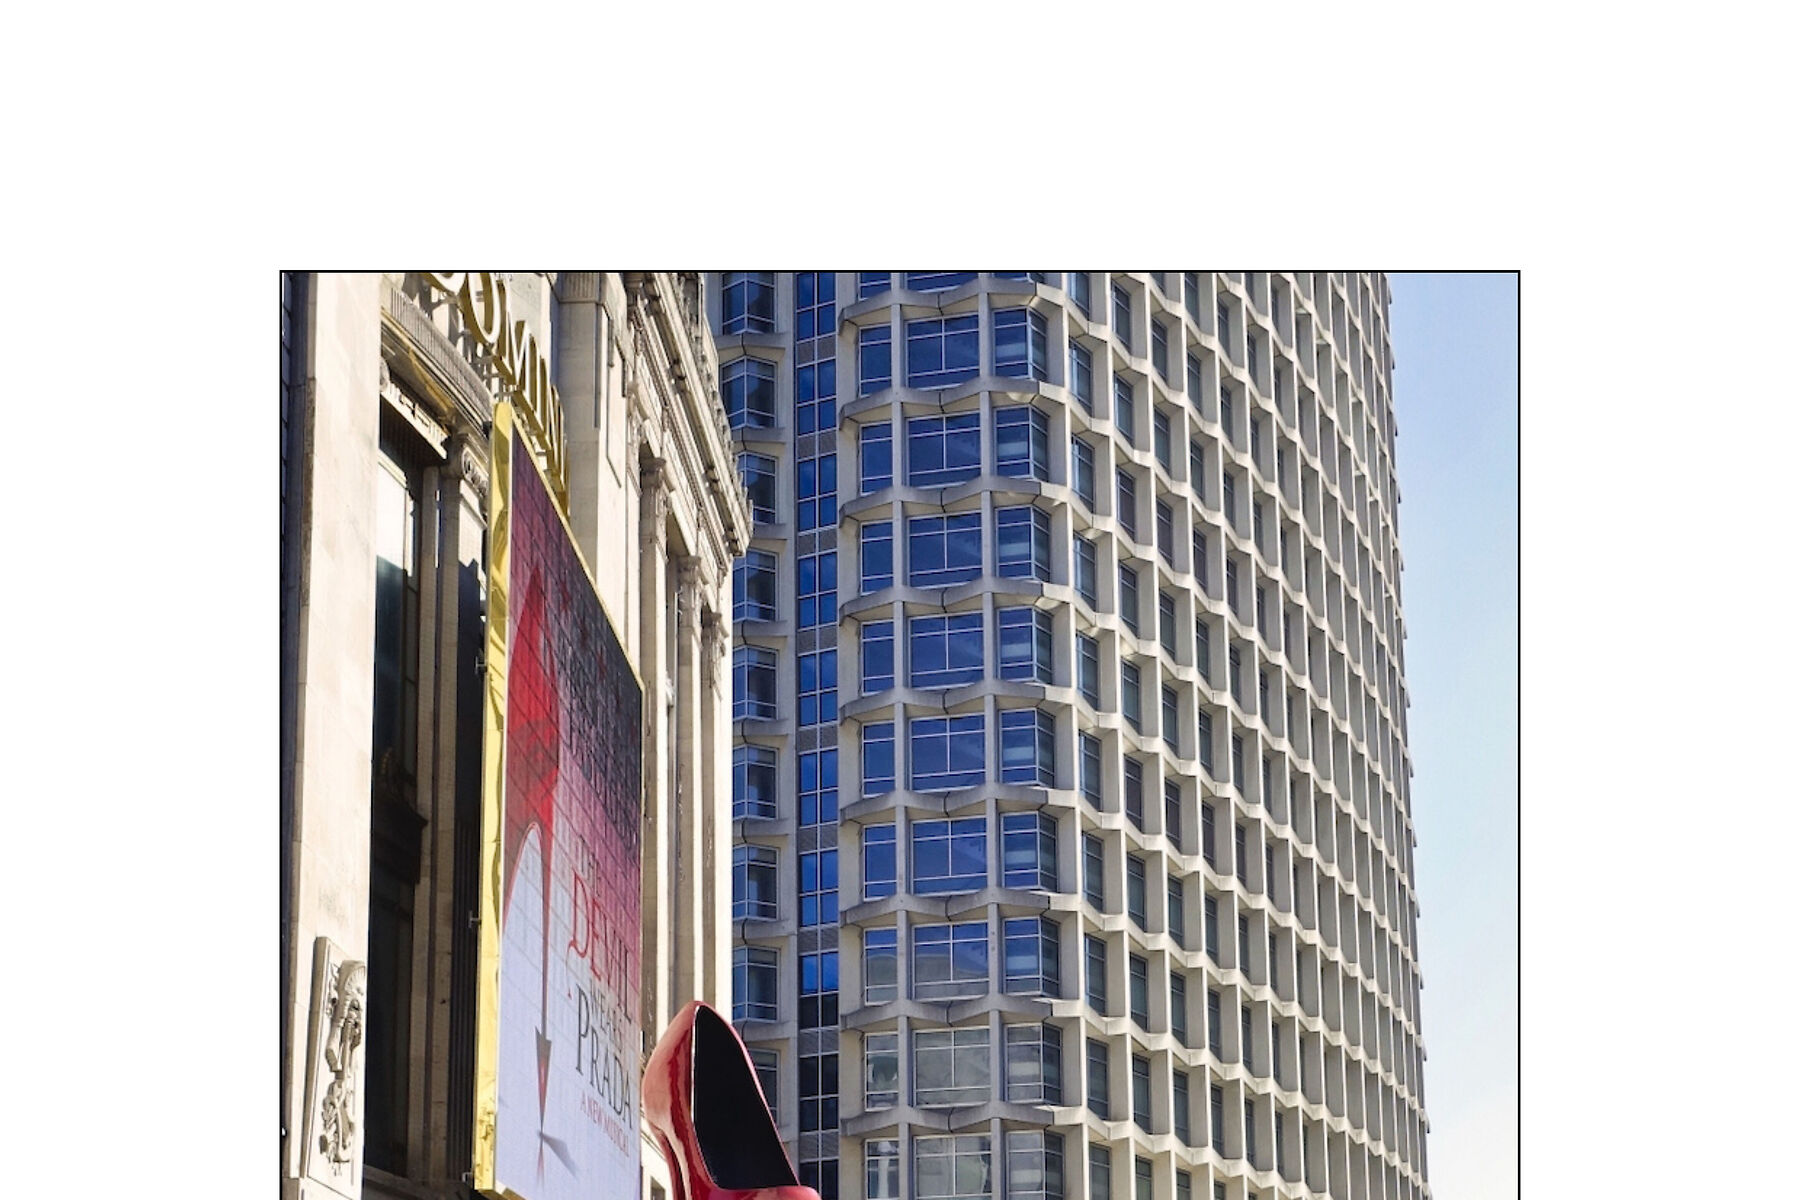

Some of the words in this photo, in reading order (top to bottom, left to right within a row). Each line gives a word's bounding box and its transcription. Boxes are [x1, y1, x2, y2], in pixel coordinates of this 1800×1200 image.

[579, 834, 602, 897] THE
[566, 868, 633, 1025] DEVIL
[589, 978, 624, 1054] WEARS
[575, 982, 633, 1130] PRADA
[603, 1114, 630, 1157] MUSICAL
